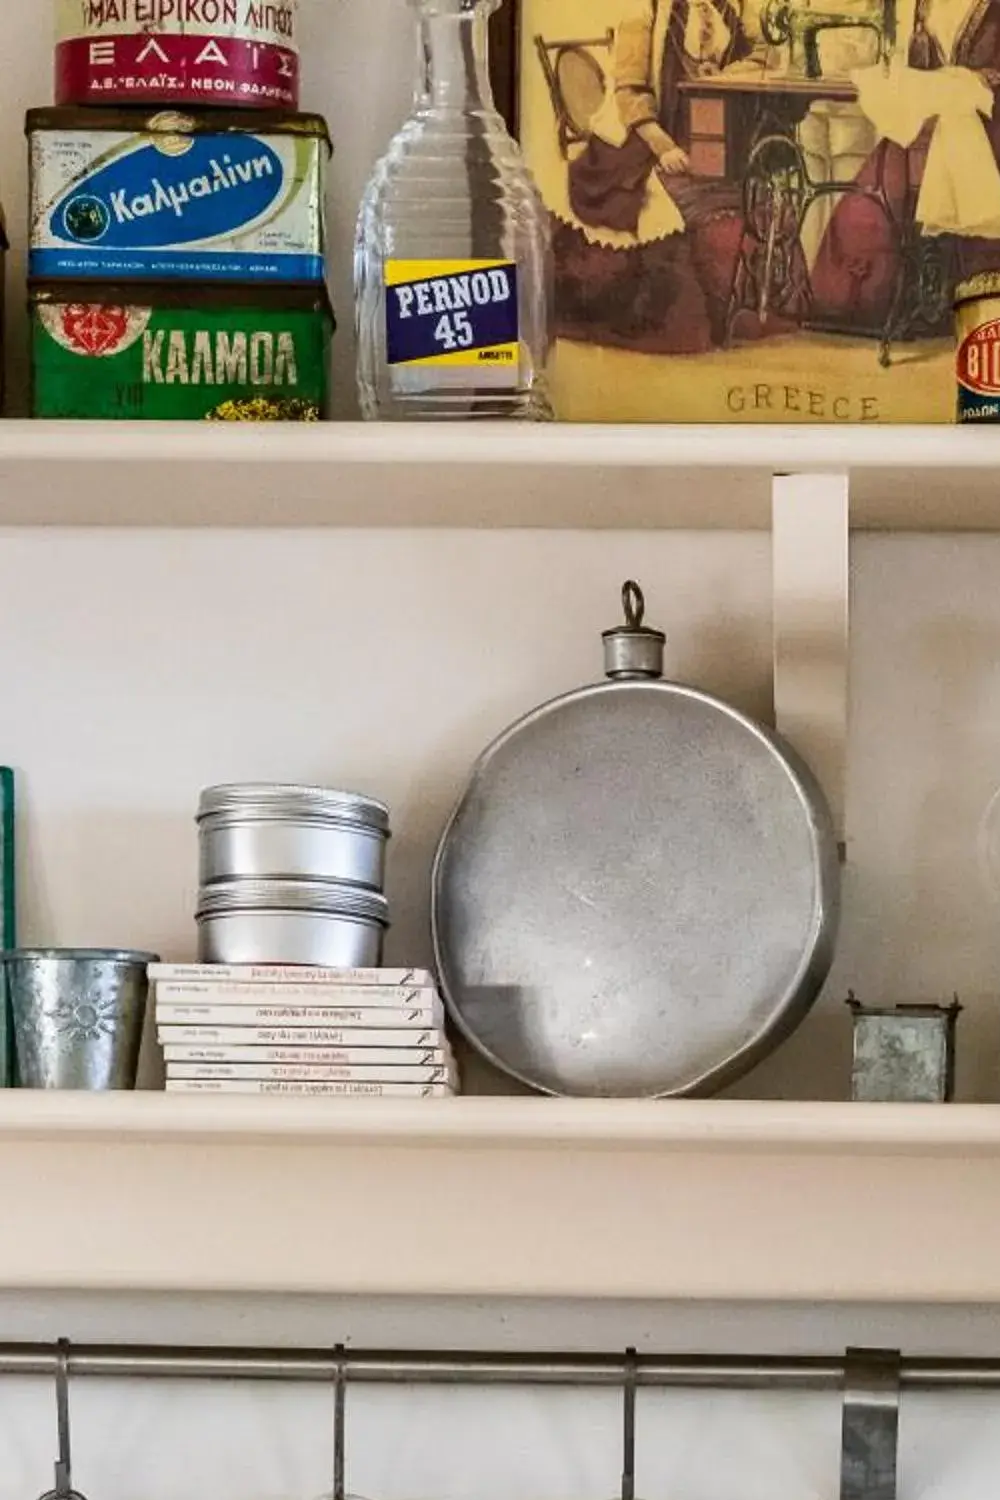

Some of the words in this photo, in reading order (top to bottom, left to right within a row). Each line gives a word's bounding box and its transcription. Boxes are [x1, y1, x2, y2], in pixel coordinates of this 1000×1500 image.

[110, 153, 273, 224] Καλμαλίνη
[395, 269, 510, 318] PERNOD
[434, 311, 474, 349] 45
[726, 384, 880, 421] GREECE
